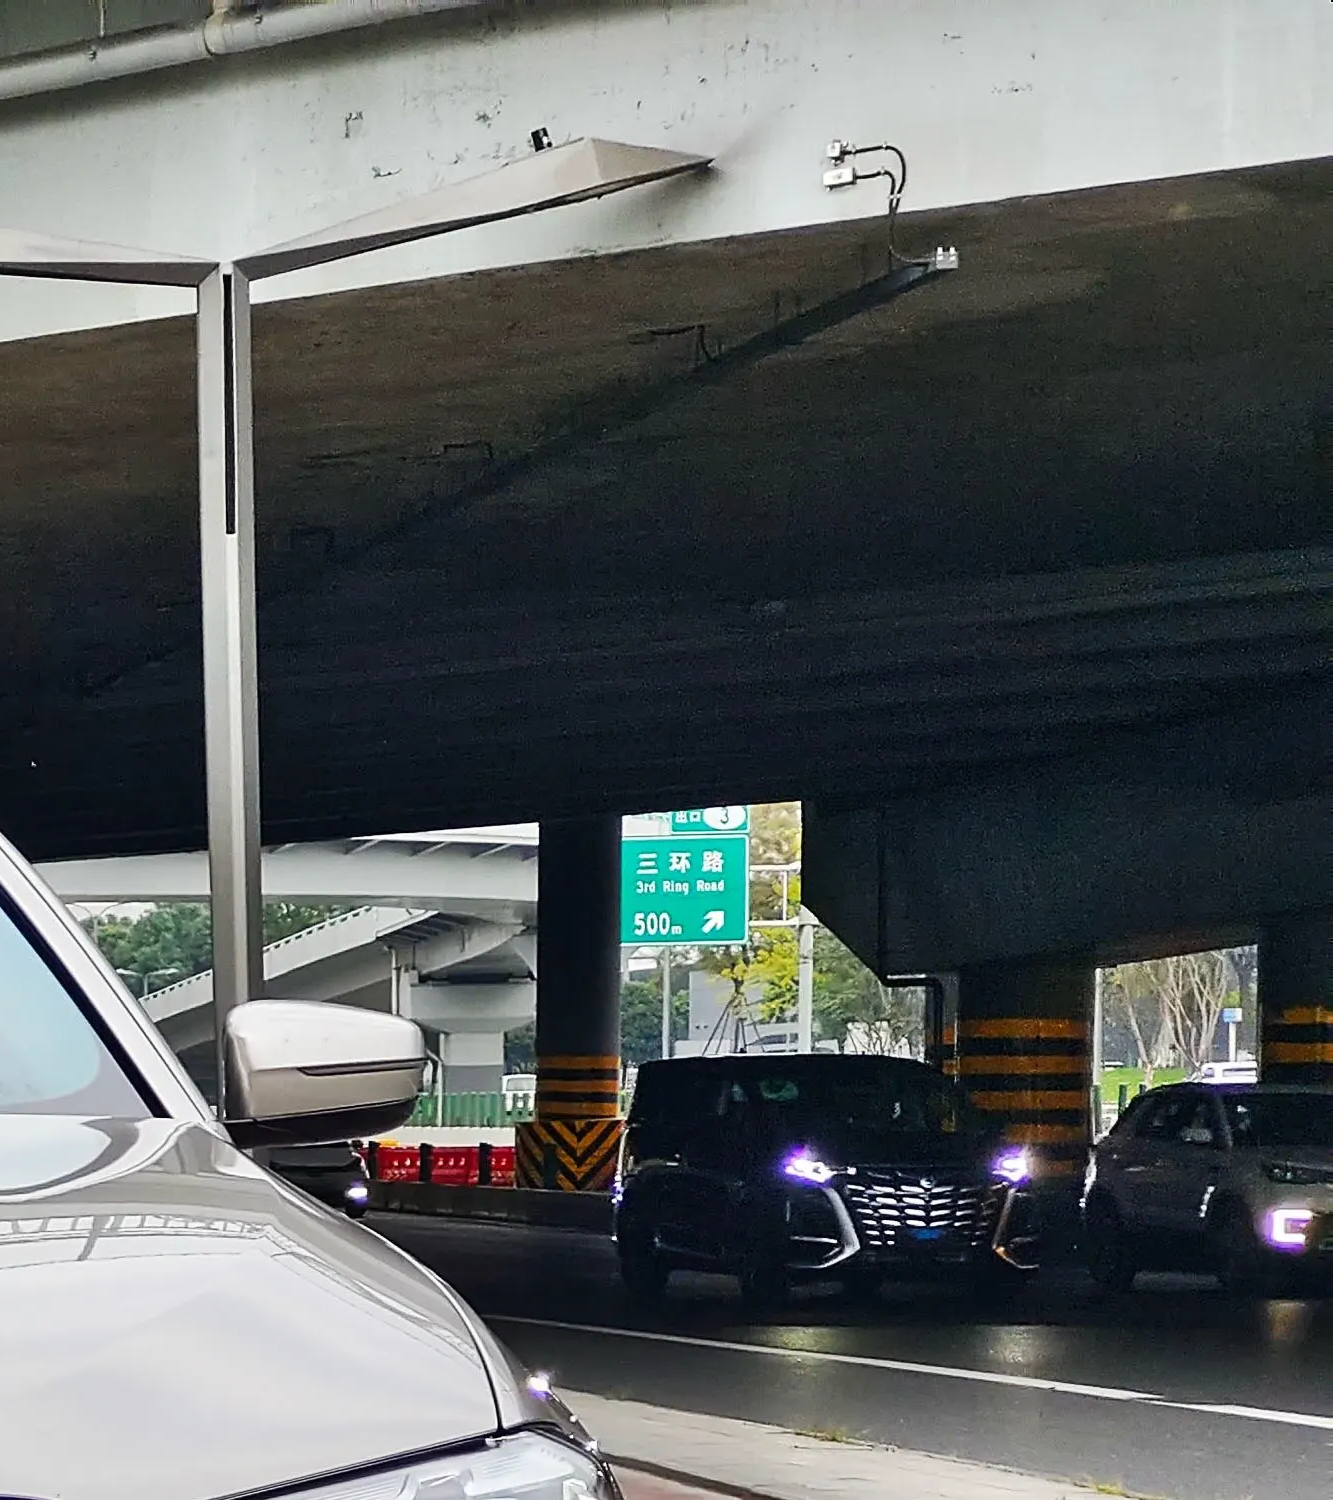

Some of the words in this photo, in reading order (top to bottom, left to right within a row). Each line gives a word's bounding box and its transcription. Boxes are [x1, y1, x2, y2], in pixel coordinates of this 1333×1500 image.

[636, 850, 724, 875] 三环路
[636, 880, 656, 894] 3rd
[663, 880, 689, 895] Ring
[696, 879, 724, 892] Road
[634, 912, 682, 936] 500m
